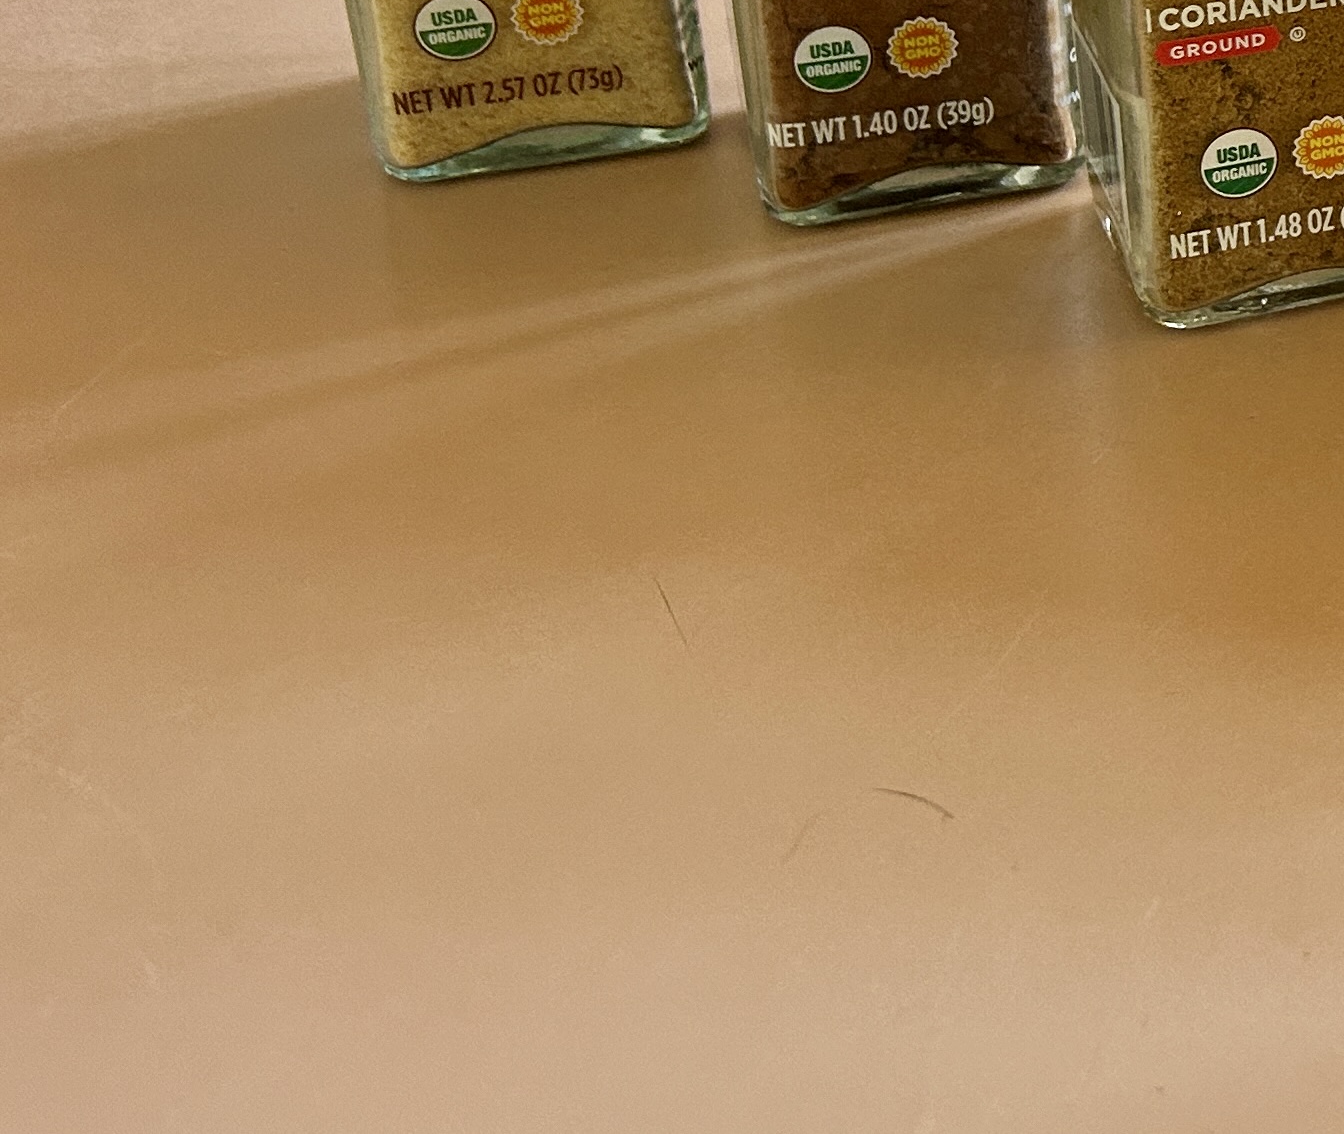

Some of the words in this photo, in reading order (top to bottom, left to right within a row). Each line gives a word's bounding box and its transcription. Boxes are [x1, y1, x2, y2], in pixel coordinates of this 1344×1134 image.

[431, 7, 478, 27] USDA
[528, 4, 564, 15] NON
[530, 14, 565, 28] GMO
[429, 26, 486, 45] ORGANIC
[904, 35, 939, 47] NON
[810, 40, 854, 60] USDA
[906, 44, 941, 58] GMO
[1170, 33, 1265, 59] GROUND
[806, 59, 862, 77] ORGANIC
[393, 89, 433, 115] NET
[439, 84, 476, 109] WT
[483, 78, 525, 104] 2.57
[534, 73, 562, 96] OZ
[568, 65, 623, 95] (73g)
[767, 122, 806, 148] NET
[811, 117, 845, 142] WT
[852, 111, 897, 138] 1.40
[904, 106, 931, 129] OZ
[937, 97, 994, 128] (39g)
[1310, 134, 1344, 149] NON
[1217, 143, 1261, 164] USDA
[1212, 161, 1267, 183] ORGANIC
[1170, 230, 1211, 259] NET
[1217, 221, 1251, 252] WT
[1257, 212, 1302, 244] 1.48
[1308, 206, 1335, 232] OZ
